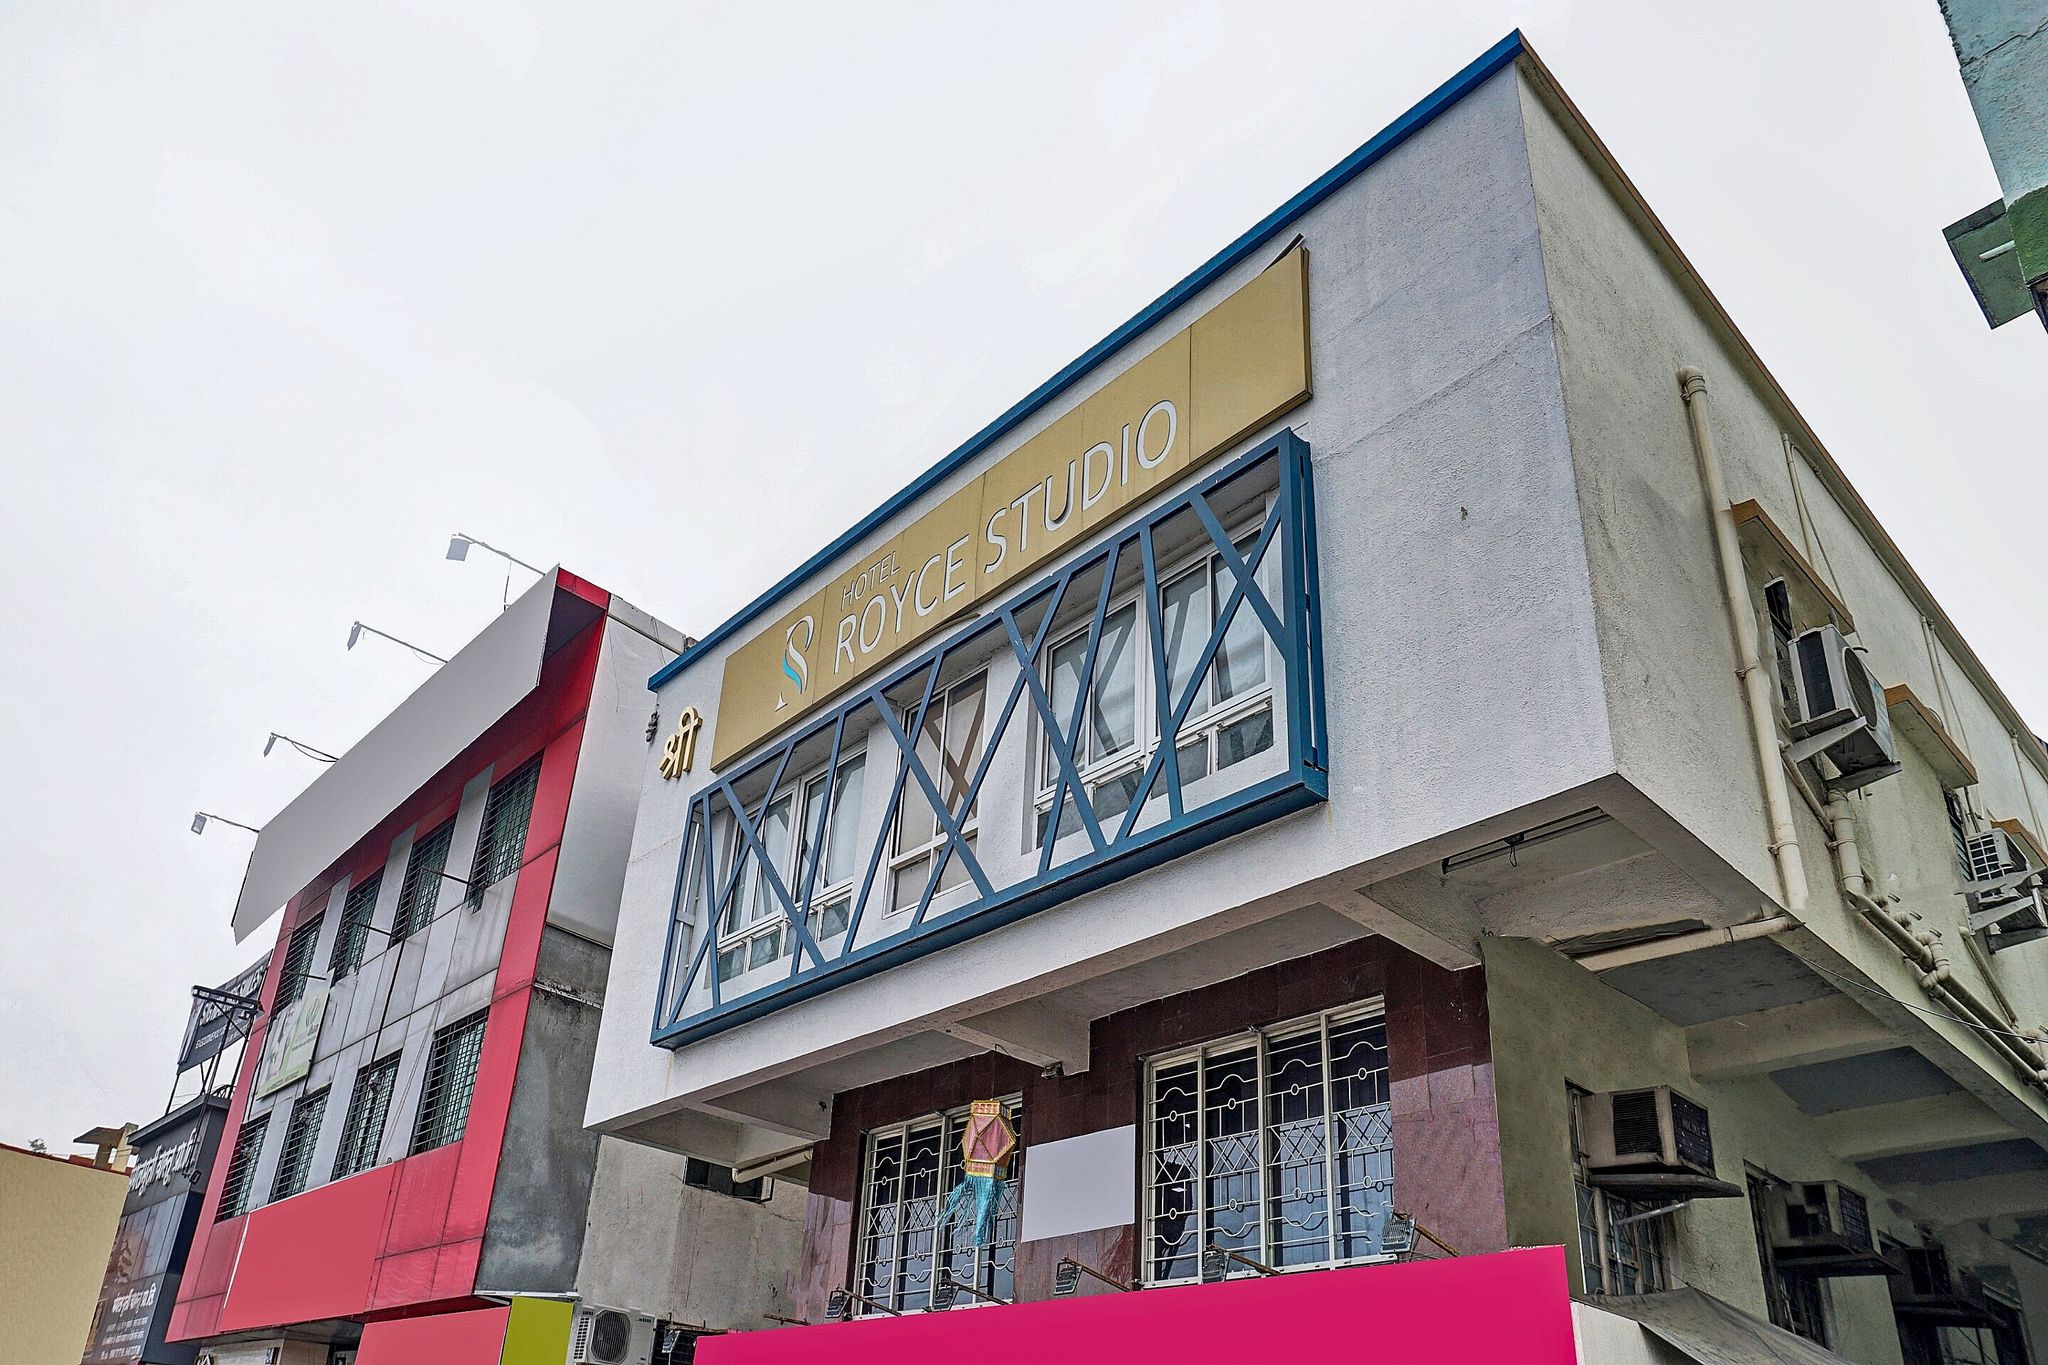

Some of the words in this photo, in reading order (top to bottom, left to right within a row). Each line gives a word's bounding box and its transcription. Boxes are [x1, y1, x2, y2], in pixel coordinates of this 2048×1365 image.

[833, 533, 970, 675] ROYCE
[984, 400, 1178, 574] STUDIO
[841, 550, 900, 612] HOTEL
[660, 706, 703, 780] श्री
